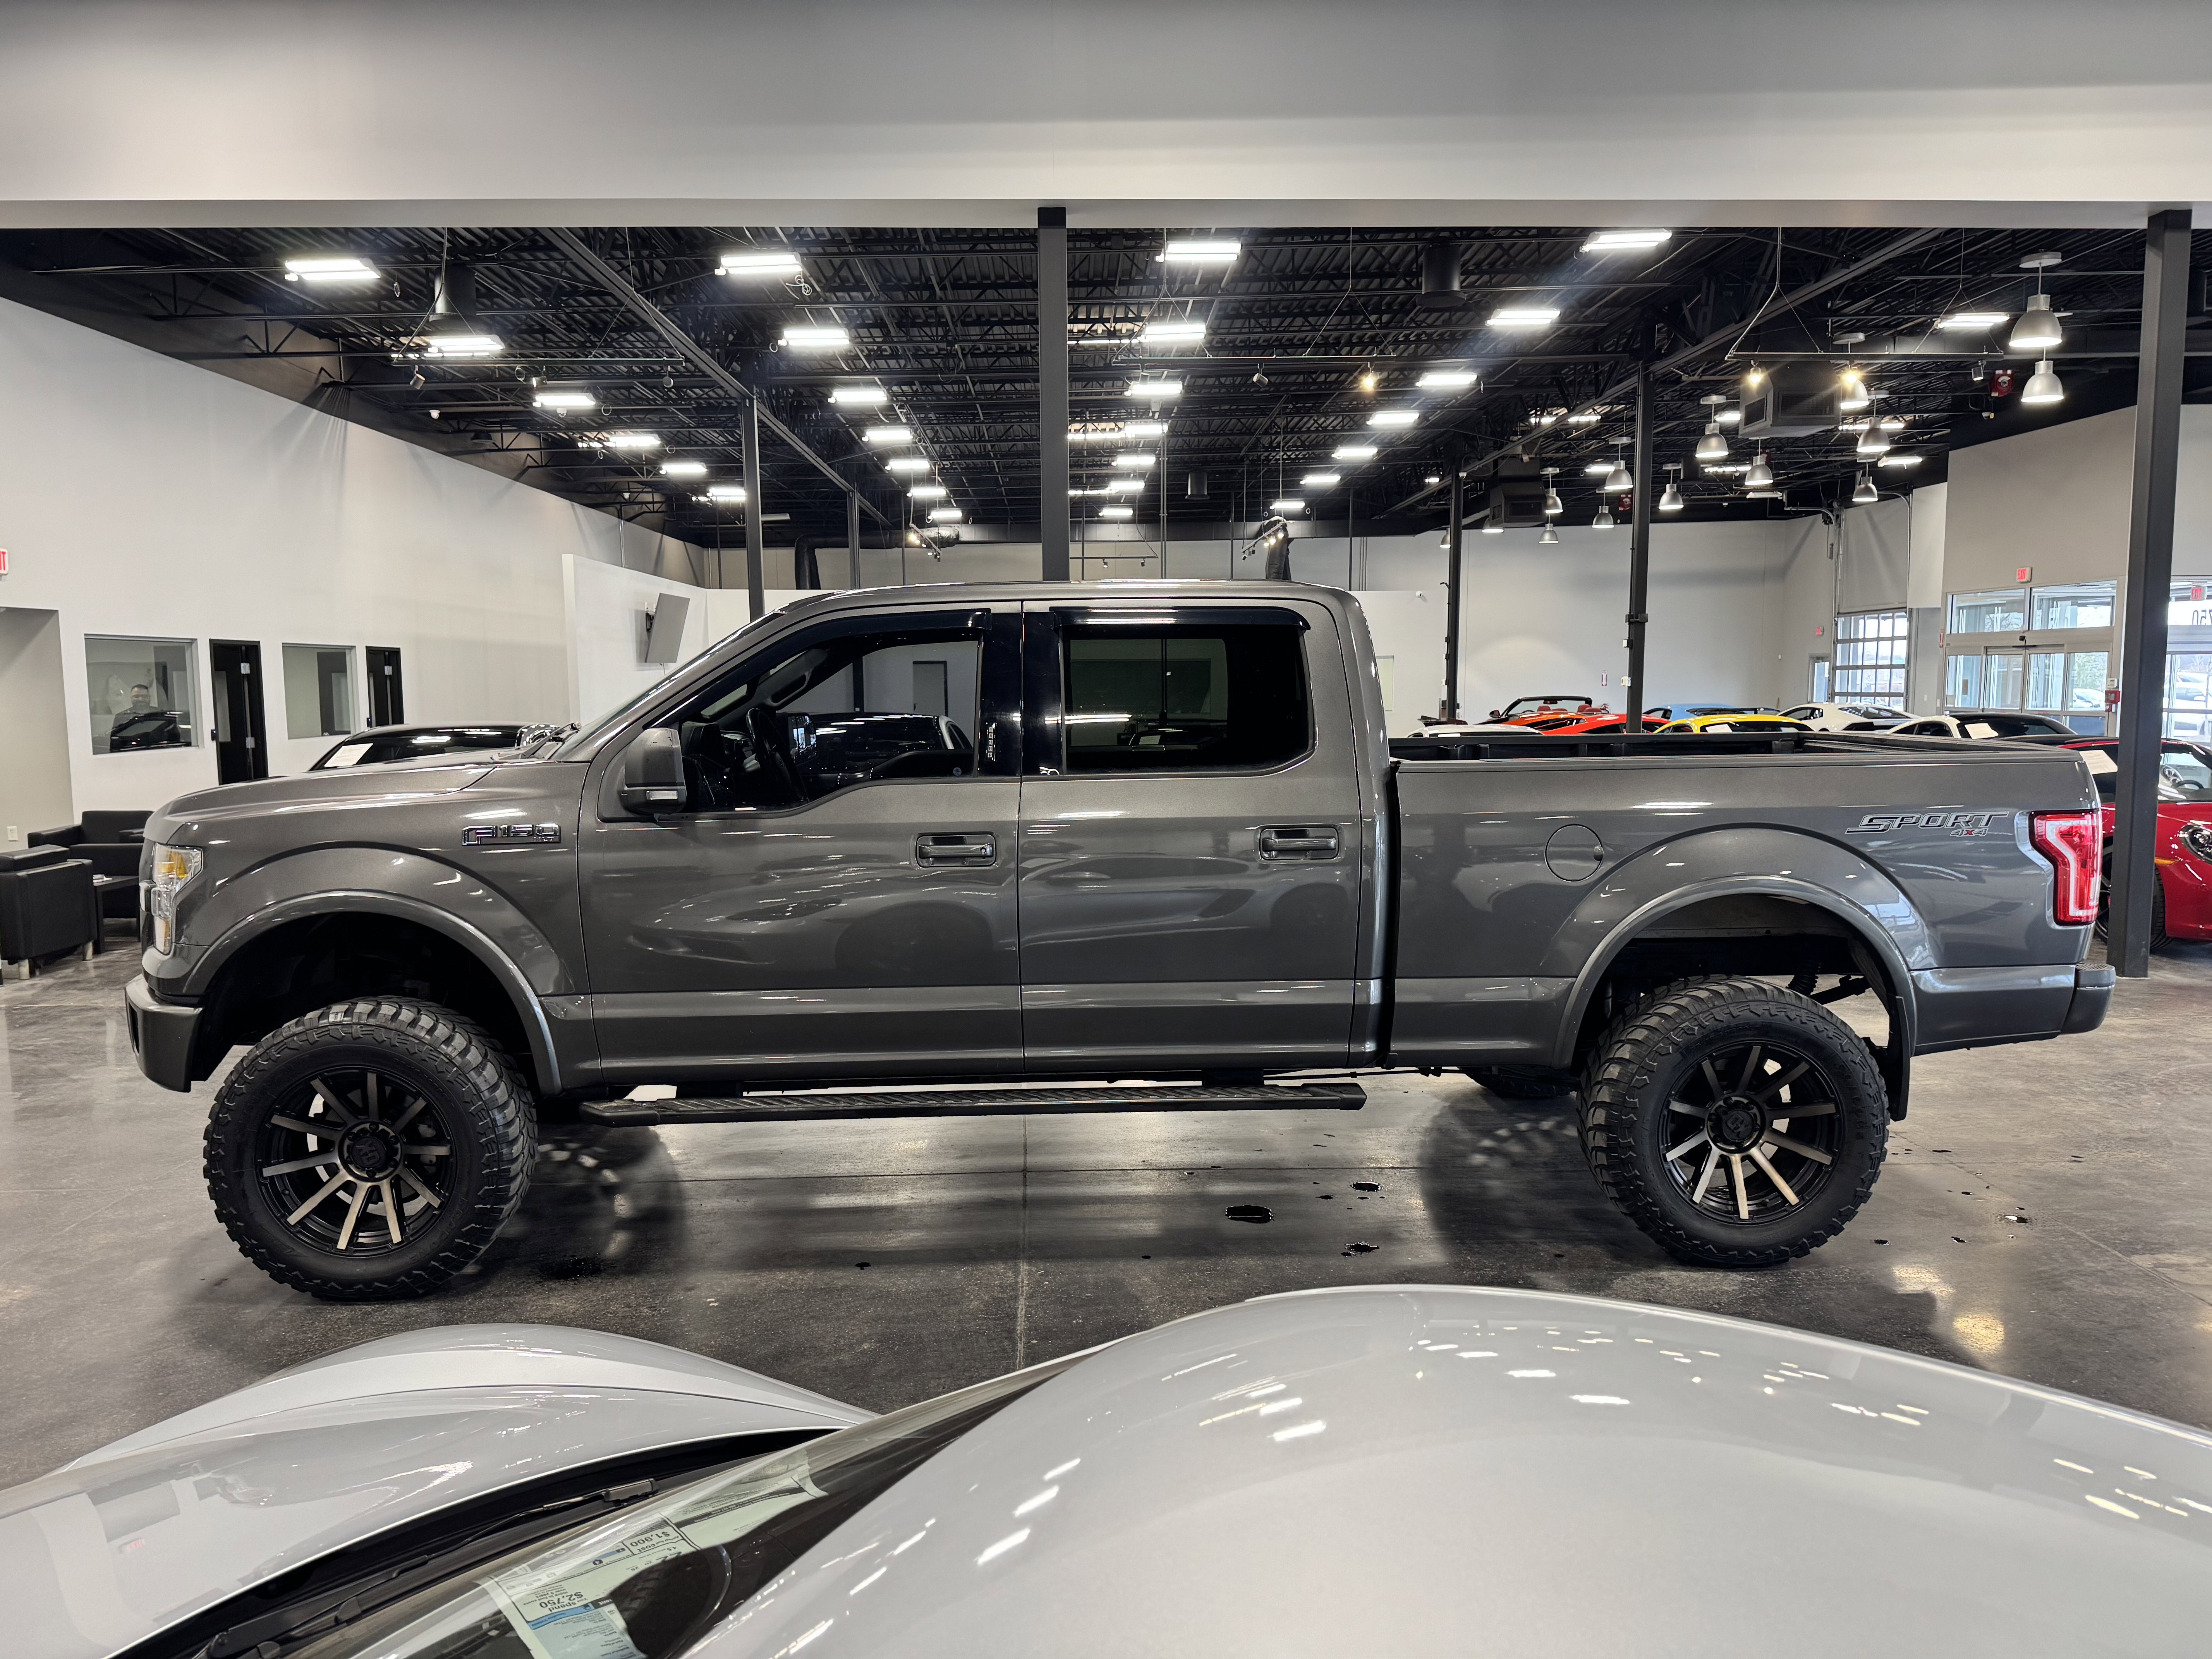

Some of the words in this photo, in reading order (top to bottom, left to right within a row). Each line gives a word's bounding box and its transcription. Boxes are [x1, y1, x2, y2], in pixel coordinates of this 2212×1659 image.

[1845, 812, 2009, 834] SPORT
[630, 1532, 670, 1547] $1,900
[539, 1592, 583, 1608] $2,750
[548, 1602, 576, 1612] spend
